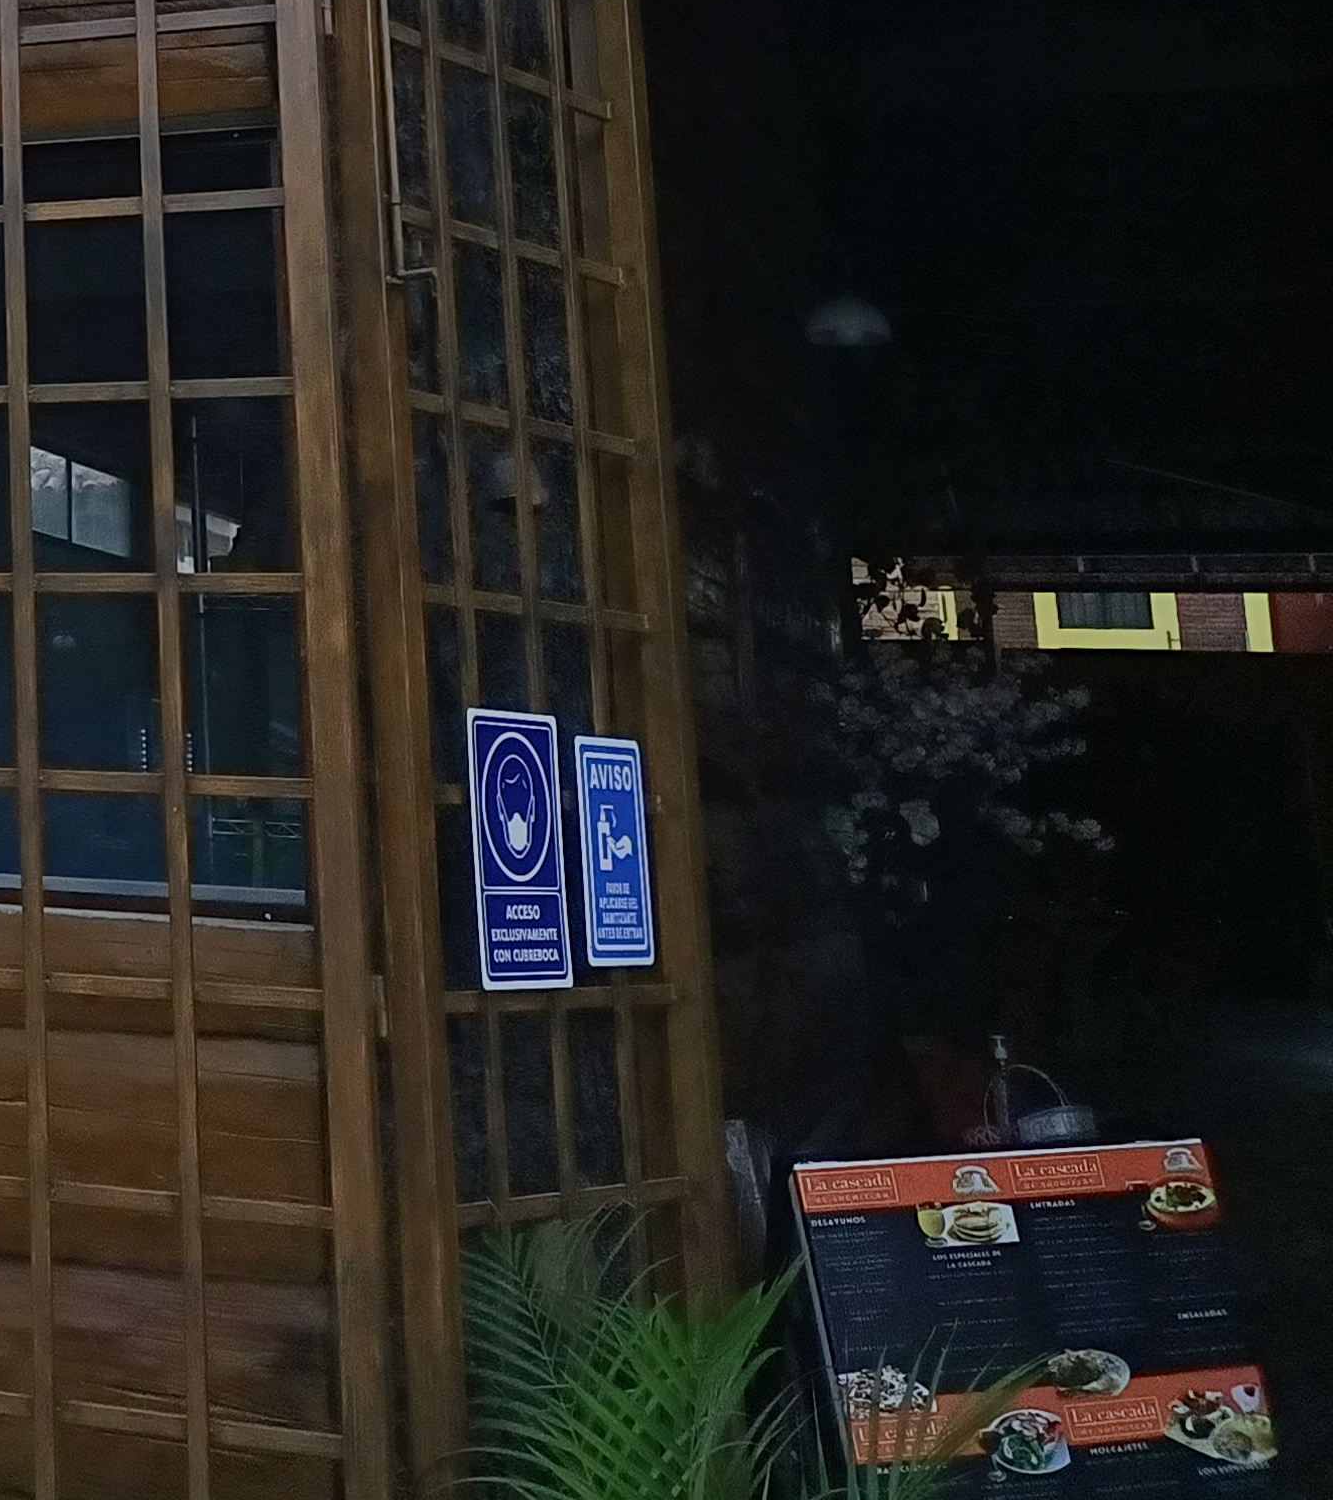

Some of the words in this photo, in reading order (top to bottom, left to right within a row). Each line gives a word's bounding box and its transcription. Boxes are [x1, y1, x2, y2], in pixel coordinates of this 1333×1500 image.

[590, 763, 632, 791] AVISO
[506, 905, 541, 920] ACCESO
[491, 927, 559, 942] EXCLUSIVAMENTE
[493, 948, 512, 963] CON
[513, 948, 560, 962] CUBREBOCA
[1013, 1162, 1036, 1178] La
[1039, 1158, 1098, 1175] cascada
[806, 1177, 828, 1192] La
[832, 1172, 893, 1190] cascada
[1029, 1199, 1076, 1210] ENTRADAS
[810, 1215, 867, 1227] DESAYUNOS
[1070, 1407, 1093, 1423] La
[1097, 1401, 1156, 1420] cascada
